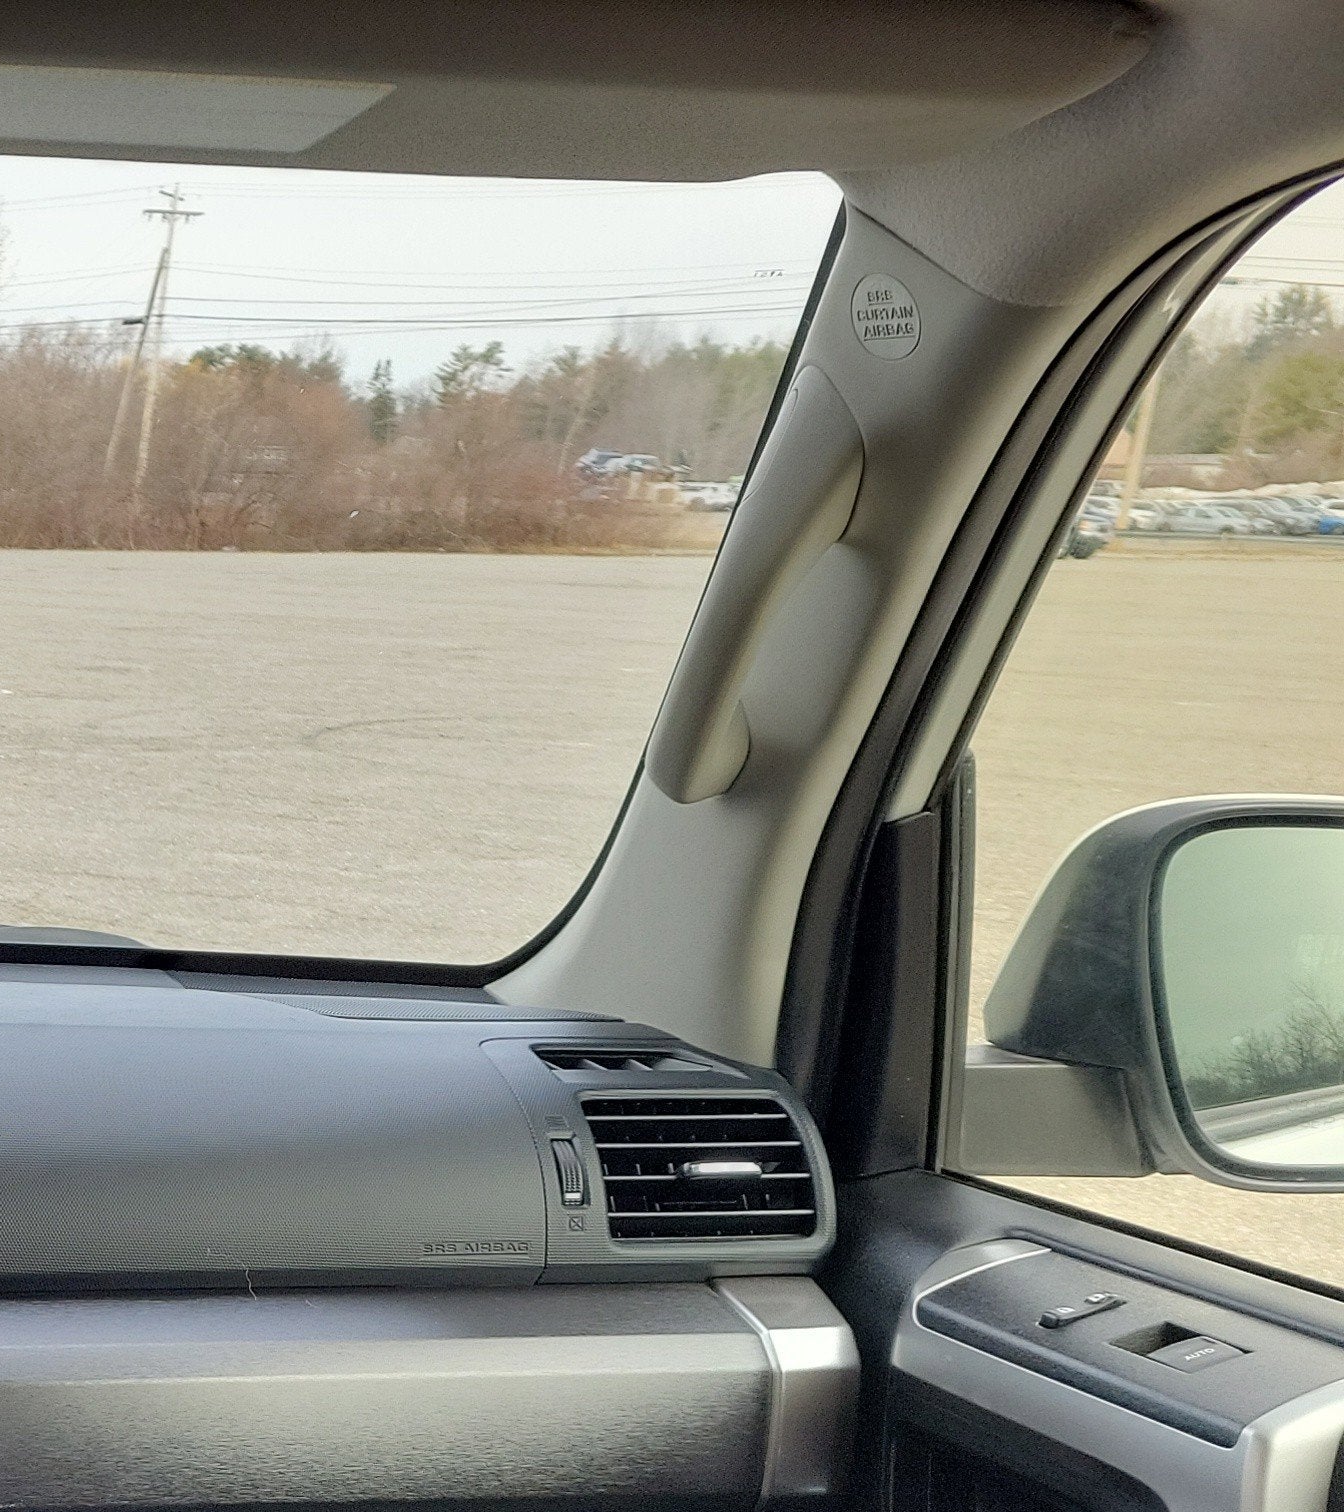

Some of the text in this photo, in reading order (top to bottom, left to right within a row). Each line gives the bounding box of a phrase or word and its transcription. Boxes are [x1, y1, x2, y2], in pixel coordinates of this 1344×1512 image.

[857, 305, 914, 322] CURTAIN
[864, 322, 914, 338] AIRBAG
[422, 1242, 529, 1253] SRS AIRBAG
[1184, 1347, 1216, 1362] AUTO
